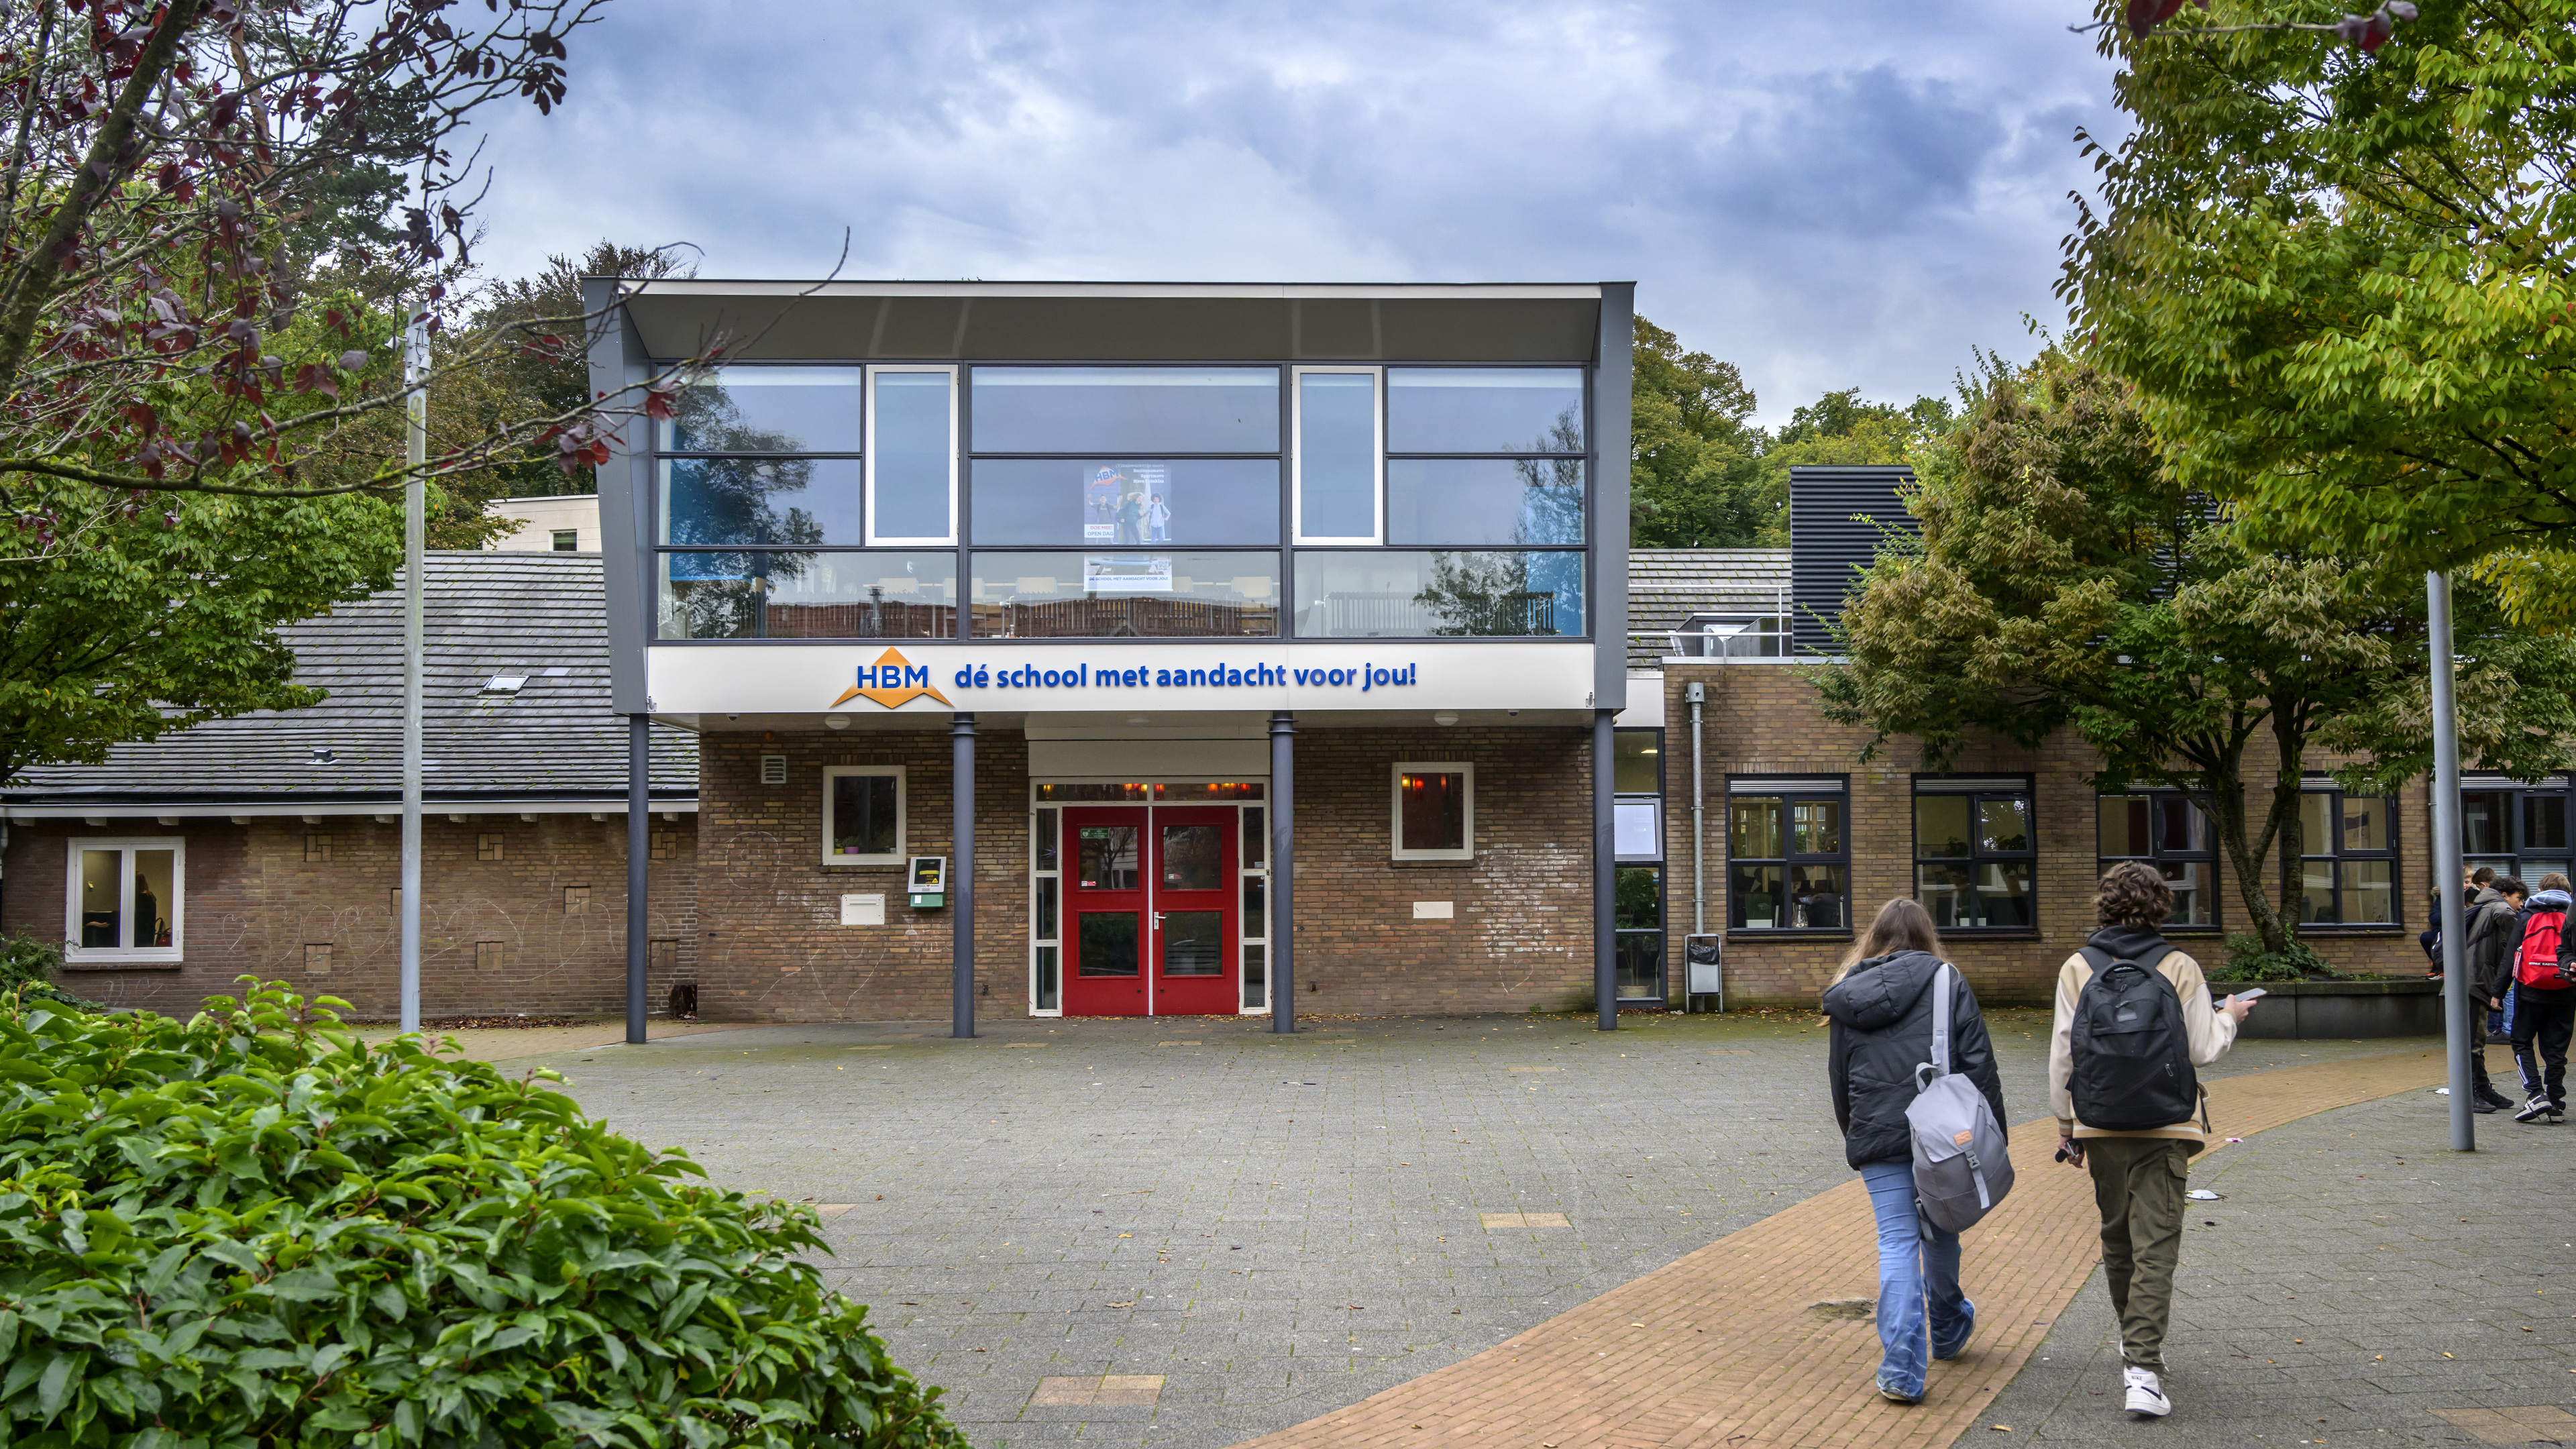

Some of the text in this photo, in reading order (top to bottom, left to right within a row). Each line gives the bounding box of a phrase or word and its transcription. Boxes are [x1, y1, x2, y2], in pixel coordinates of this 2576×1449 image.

[1094, 469, 1118, 482] HBM
[857, 665, 928, 688] HBM
[955, 662, 1416, 692] dé school met aandacht voor jou!
